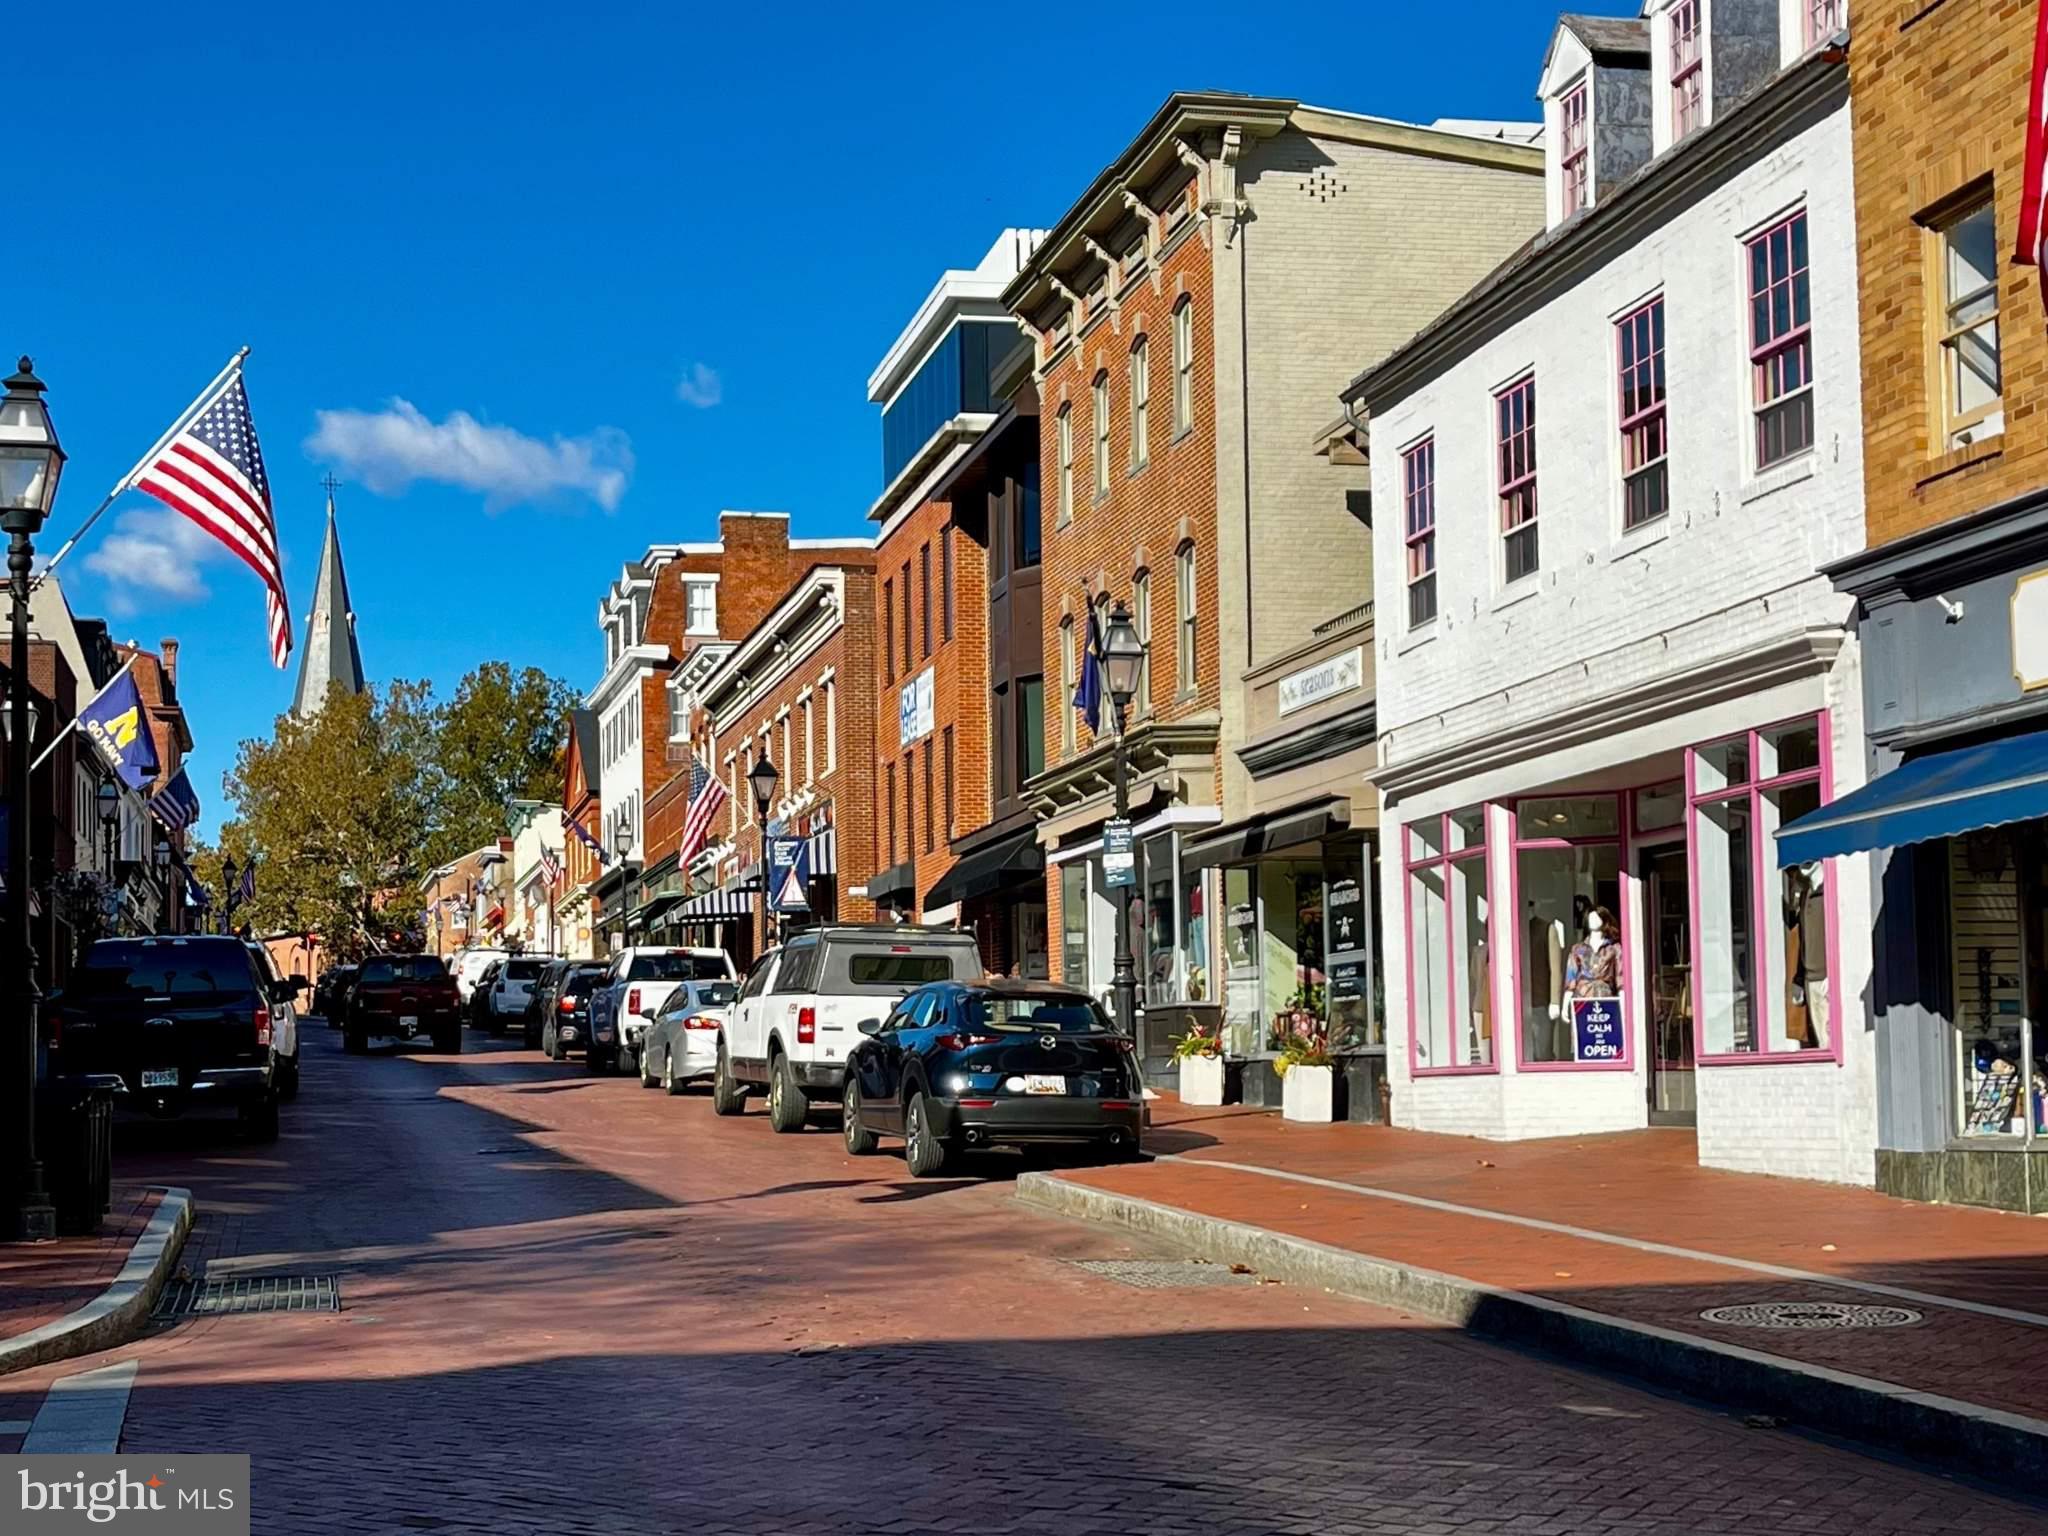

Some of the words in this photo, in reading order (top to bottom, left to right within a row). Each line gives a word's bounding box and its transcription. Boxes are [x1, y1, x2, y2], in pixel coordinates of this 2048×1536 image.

[1301, 667, 1334, 697] seasons
[87, 720, 104, 739] GO
[99, 736, 124, 766] NAVY
[1586, 1013, 1610, 1022] KEEP
[1586, 1024, 1612, 1033] CALM
[1584, 1045, 1617, 1056] OPEN
